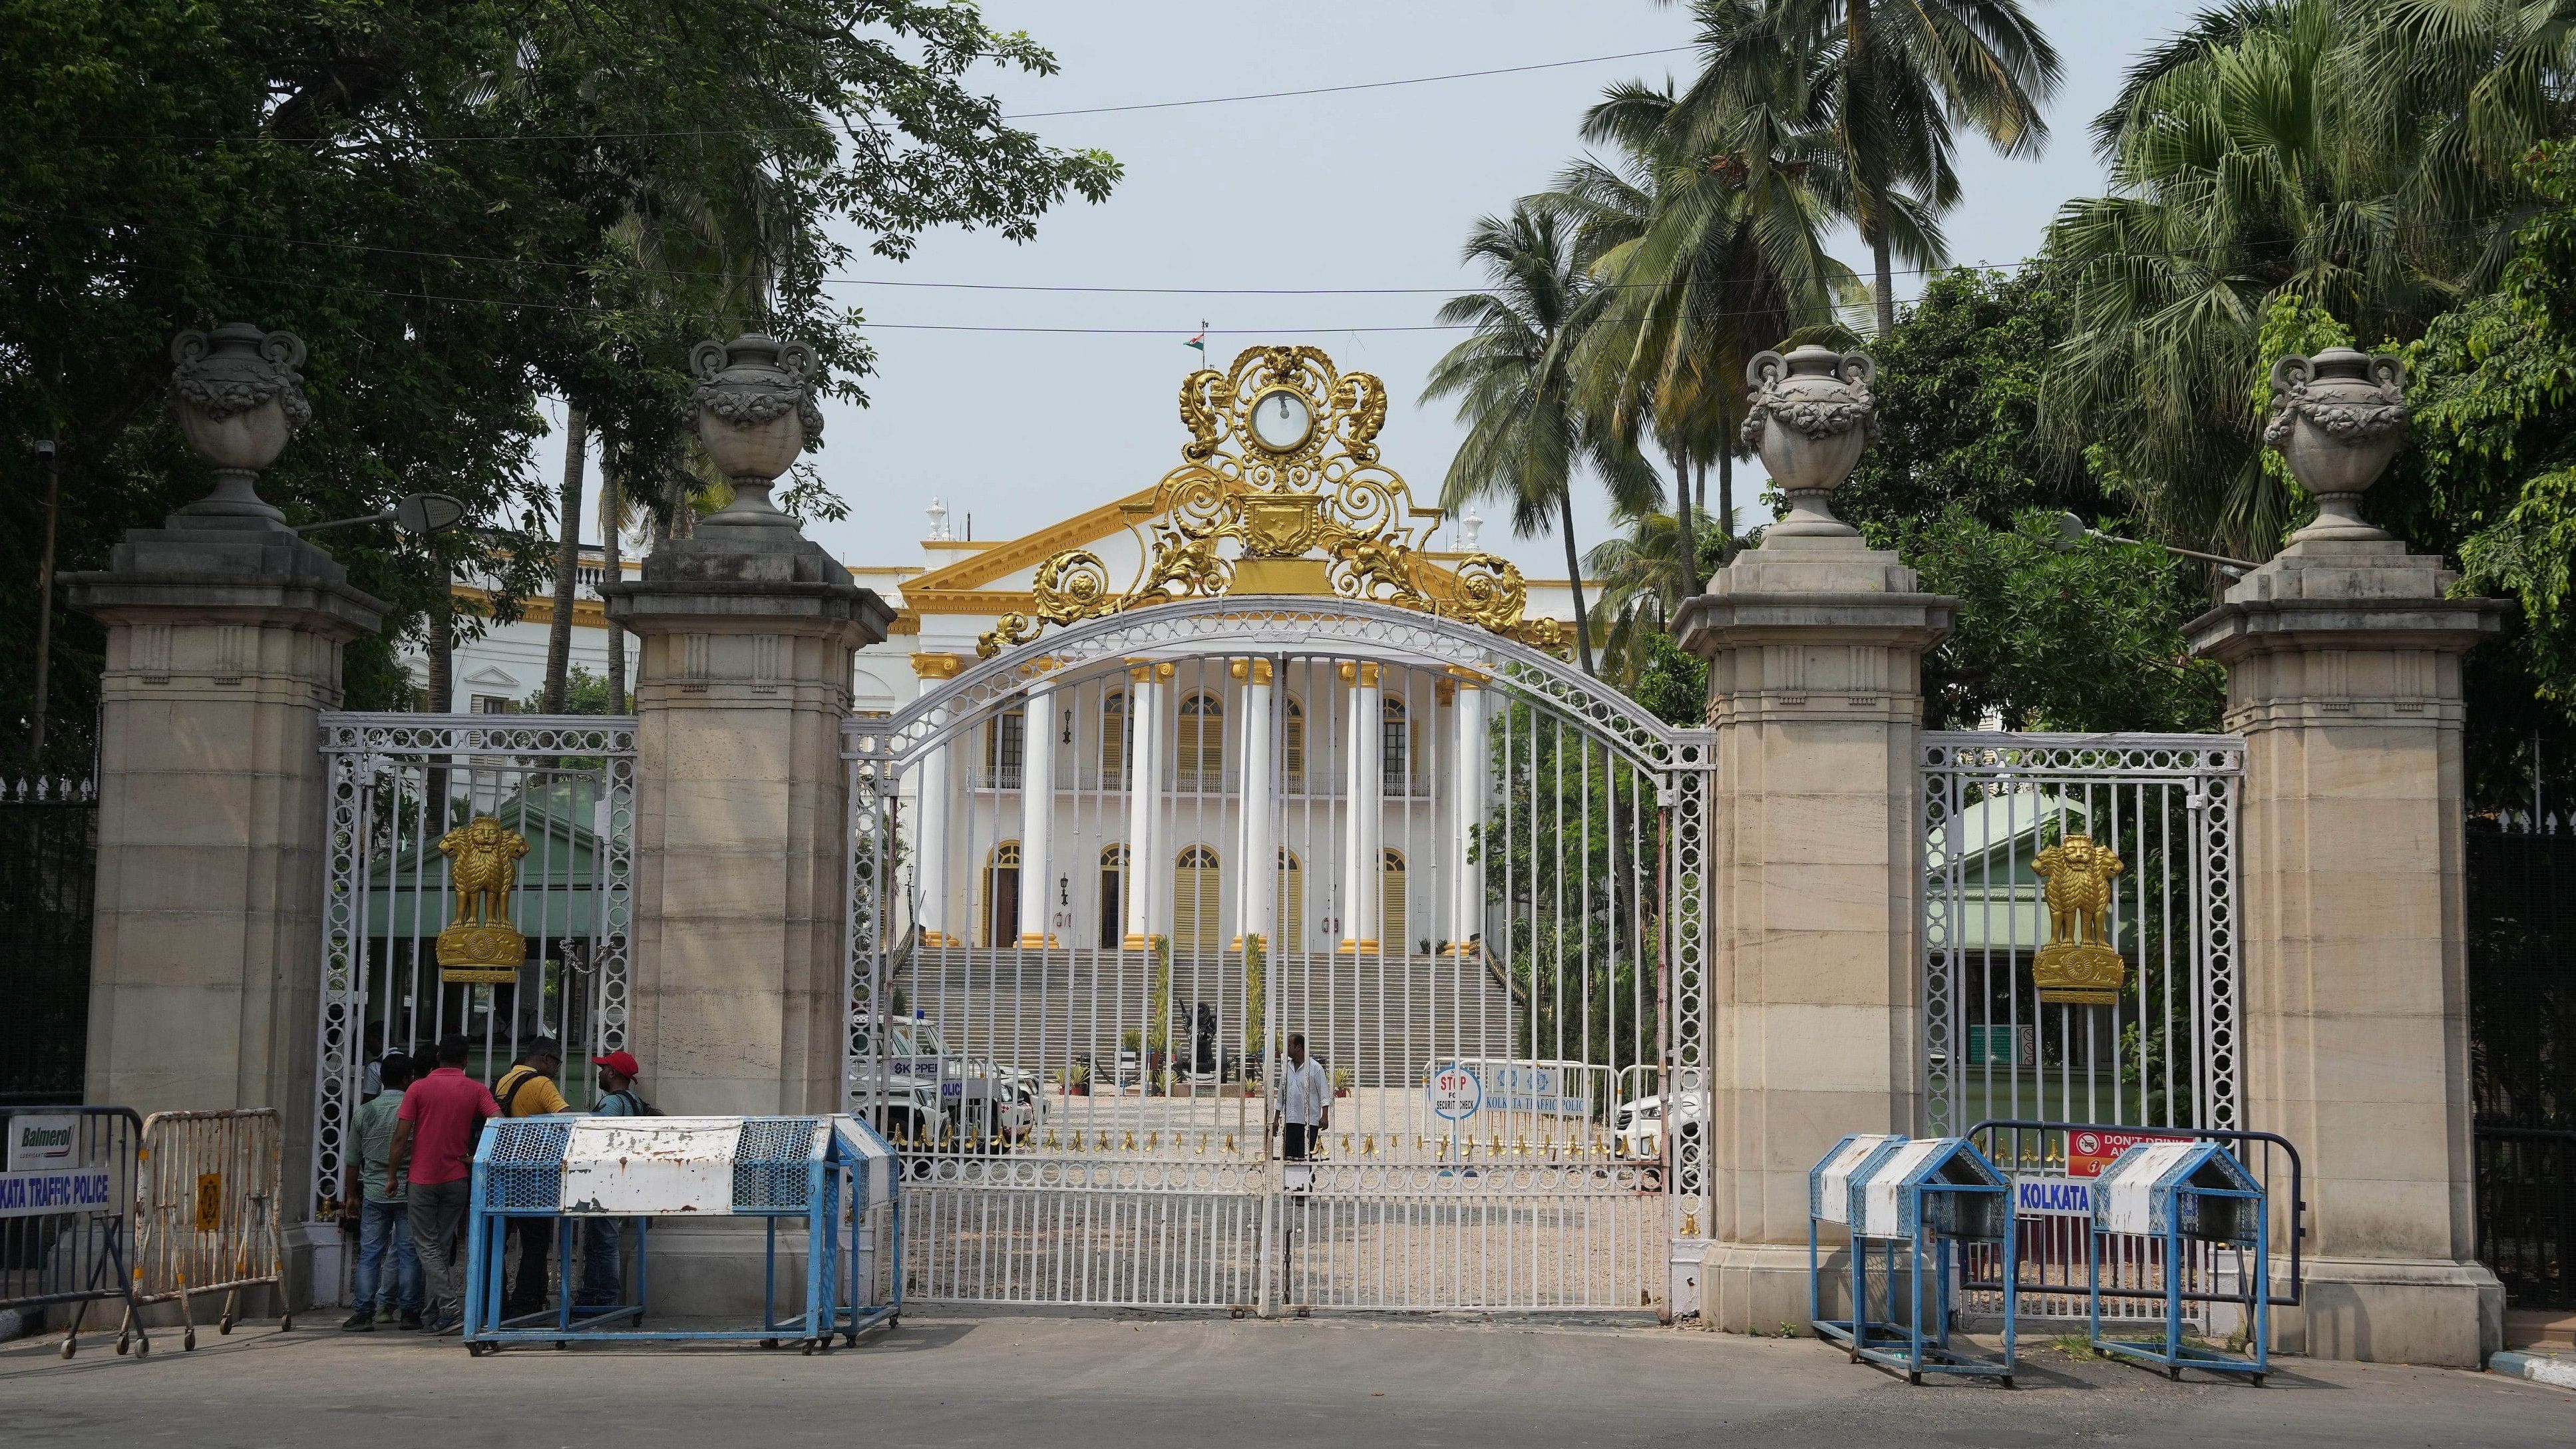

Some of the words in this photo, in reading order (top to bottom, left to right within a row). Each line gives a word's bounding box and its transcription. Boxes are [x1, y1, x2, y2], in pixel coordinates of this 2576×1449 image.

[894, 1062, 938, 1074] SKPPE
[942, 1083, 962, 1097] OLIC
[1441, 1076, 1466, 1091] STP
[1436, 1100, 1455, 1110] SECURIT
[1487, 1097, 1521, 1109] KOLKTA
[1562, 1100, 1584, 1111] POLIC
[21, 1126, 72, 1147] Balmerol
[29, 1176, 71, 1207] TRAFFIC
[73, 1174, 108, 1204] POLICE
[2020, 1183, 2090, 1211] KOLKATA
